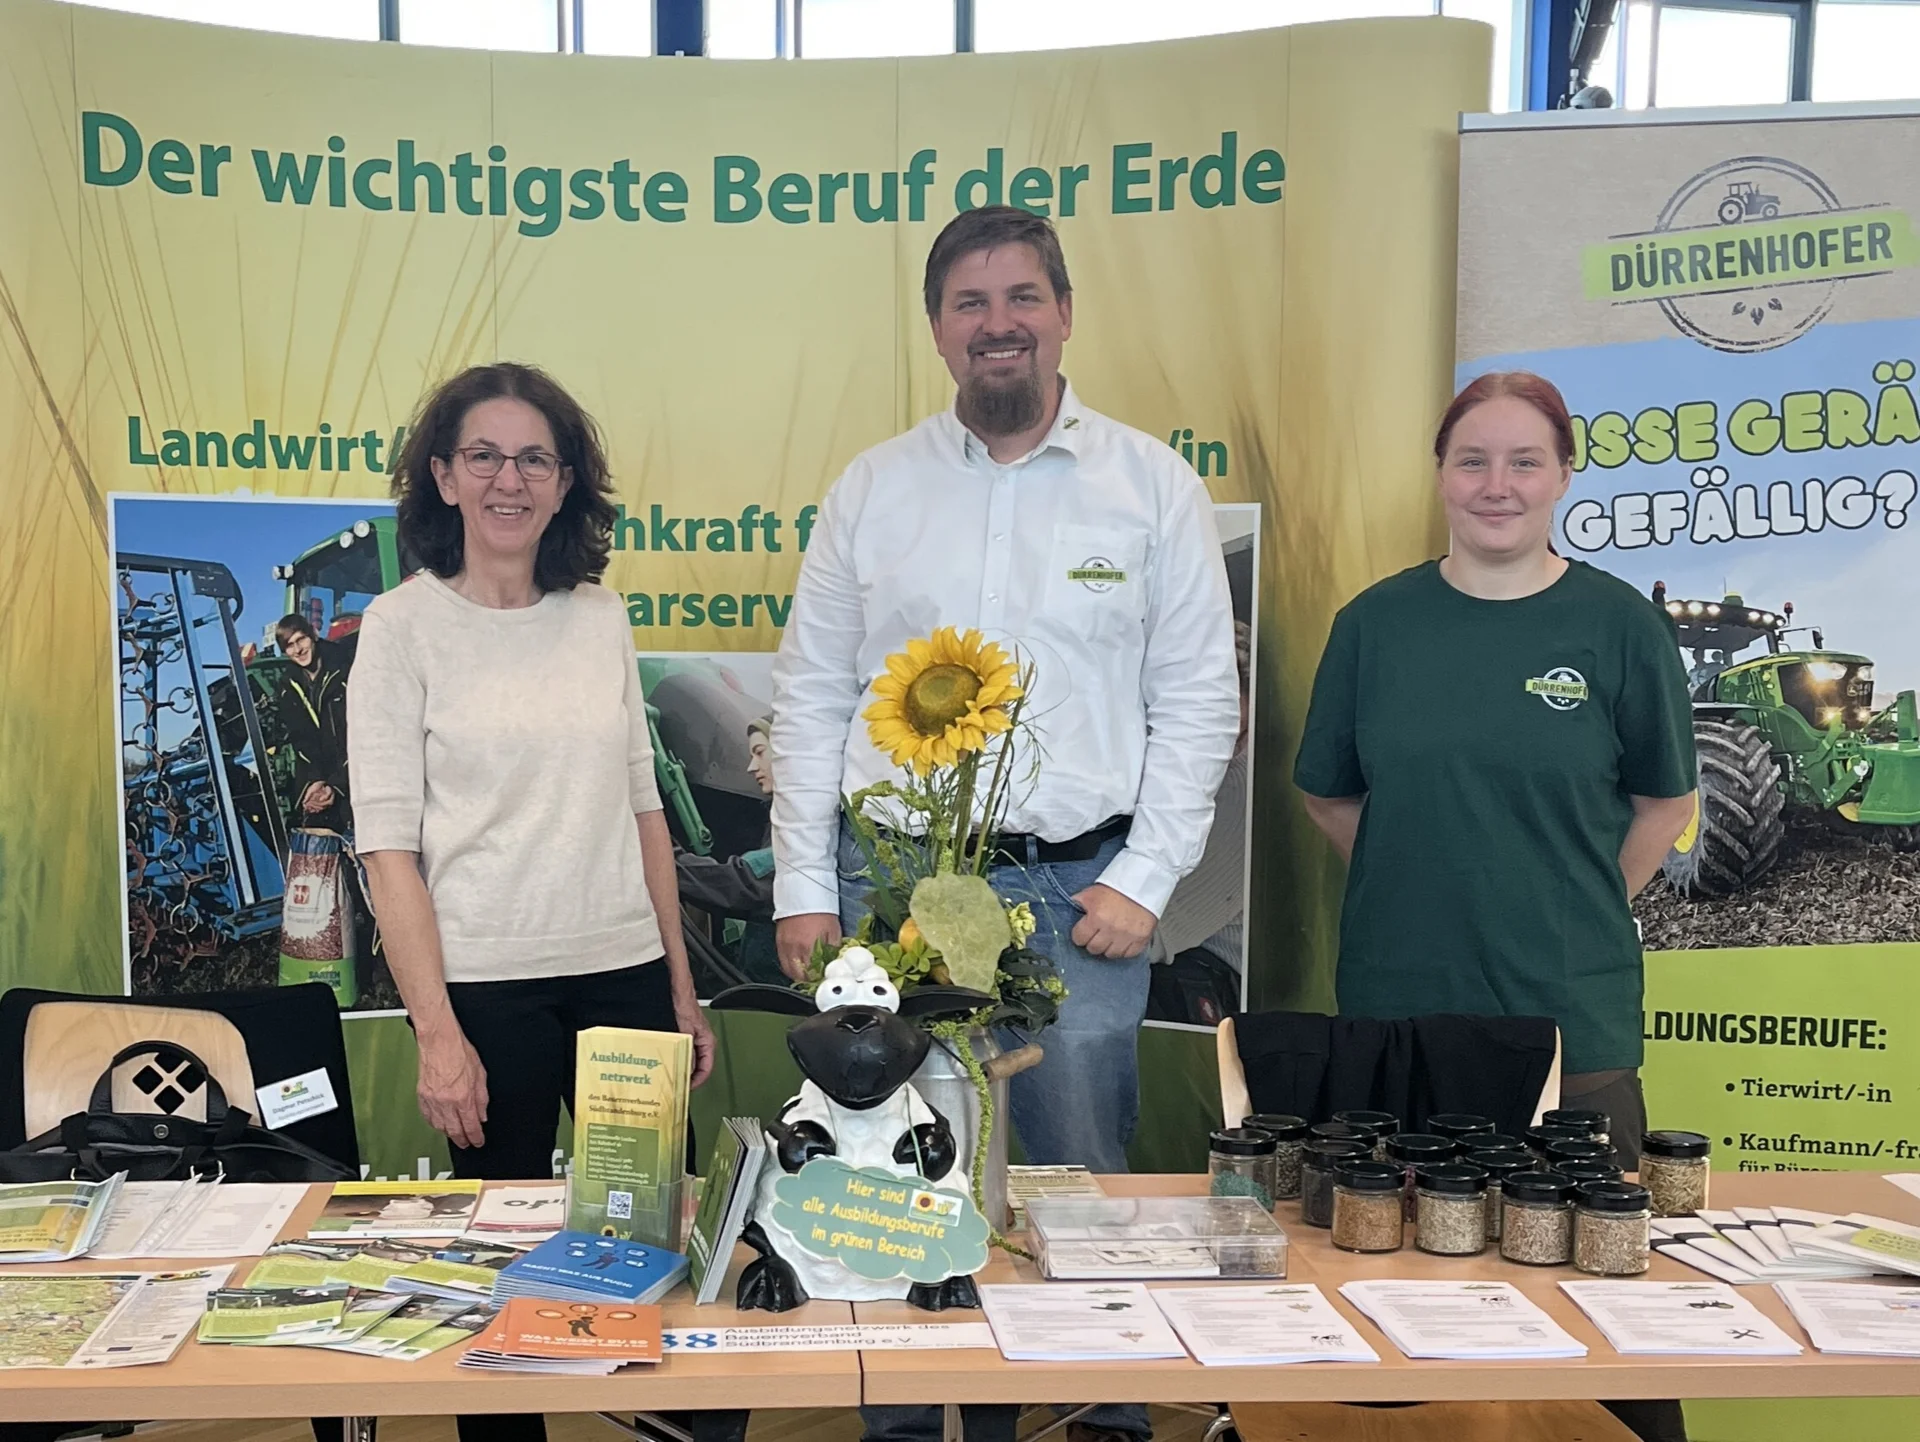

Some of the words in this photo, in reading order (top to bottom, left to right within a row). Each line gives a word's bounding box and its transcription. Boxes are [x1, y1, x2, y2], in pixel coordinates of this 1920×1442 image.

[82, 111, 231, 197] Der
[251, 135, 689, 238] wichtigste
[713, 149, 937, 224] Beruf
[955, 147, 1089, 217] der
[1112, 131, 1286, 214] Erde
[1610, 222, 1893, 292] DÜRRENHOFER
[1570, 400, 1720, 472] ISSE
[1727, 359, 1920, 456] GERÄ
[1563, 466, 1917, 551] GEFÄLLIG?
[618, 592, 794, 627] arserv
[590, 1051, 662, 1069] Ausbildungs-
[600, 1072, 651, 1085] netzwerk
[1741, 1078, 1892, 1103] Tierwirt/-in
[1739, 1133, 1920, 1159] Kaufmann/-fr
[846, 1178, 875, 1198] Hier
[879, 1188, 906, 1204] sind
[802, 1196, 825, 1214] alle
[830, 1202, 945, 1239] Ausbildungsberufe
[811, 1223, 827, 1240] im
[831, 1231, 873, 1250] grünen
[877, 1237, 925, 1262] Bereich
[724, 1324, 912, 1334] Ausbildungsnetzwerk
[724, 1332, 862, 1341] Bauernverband
[725, 1338, 876, 1348] Südbrandenburg
